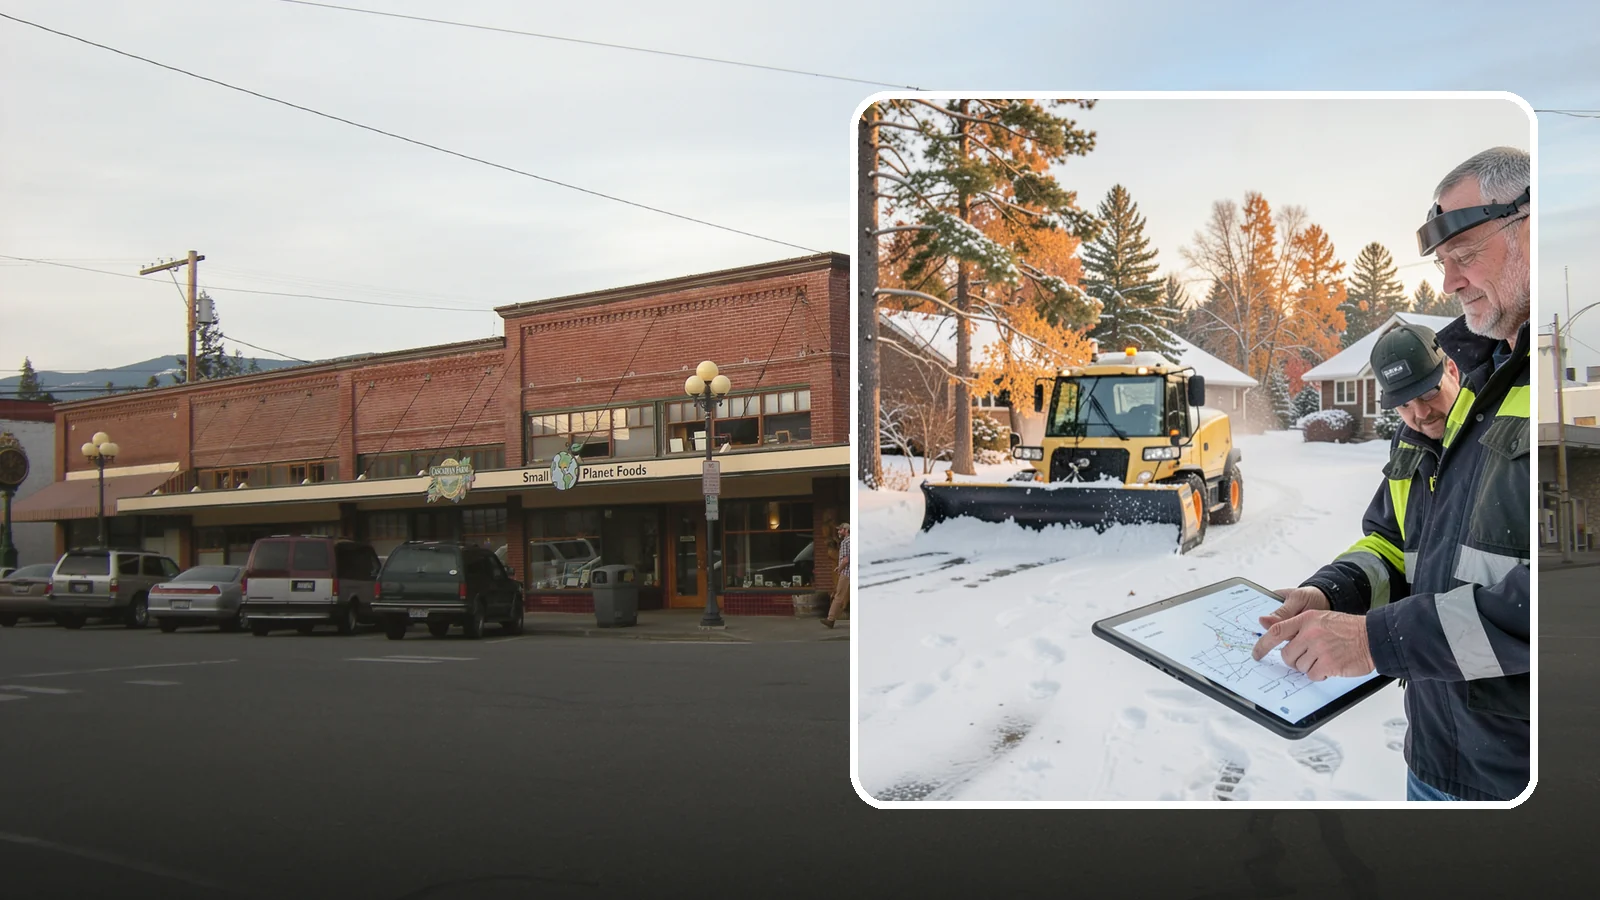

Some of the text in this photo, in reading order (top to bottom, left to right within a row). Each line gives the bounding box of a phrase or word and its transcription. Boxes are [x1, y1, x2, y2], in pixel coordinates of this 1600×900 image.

[523, 464, 647, 483] Small Planet Foods
